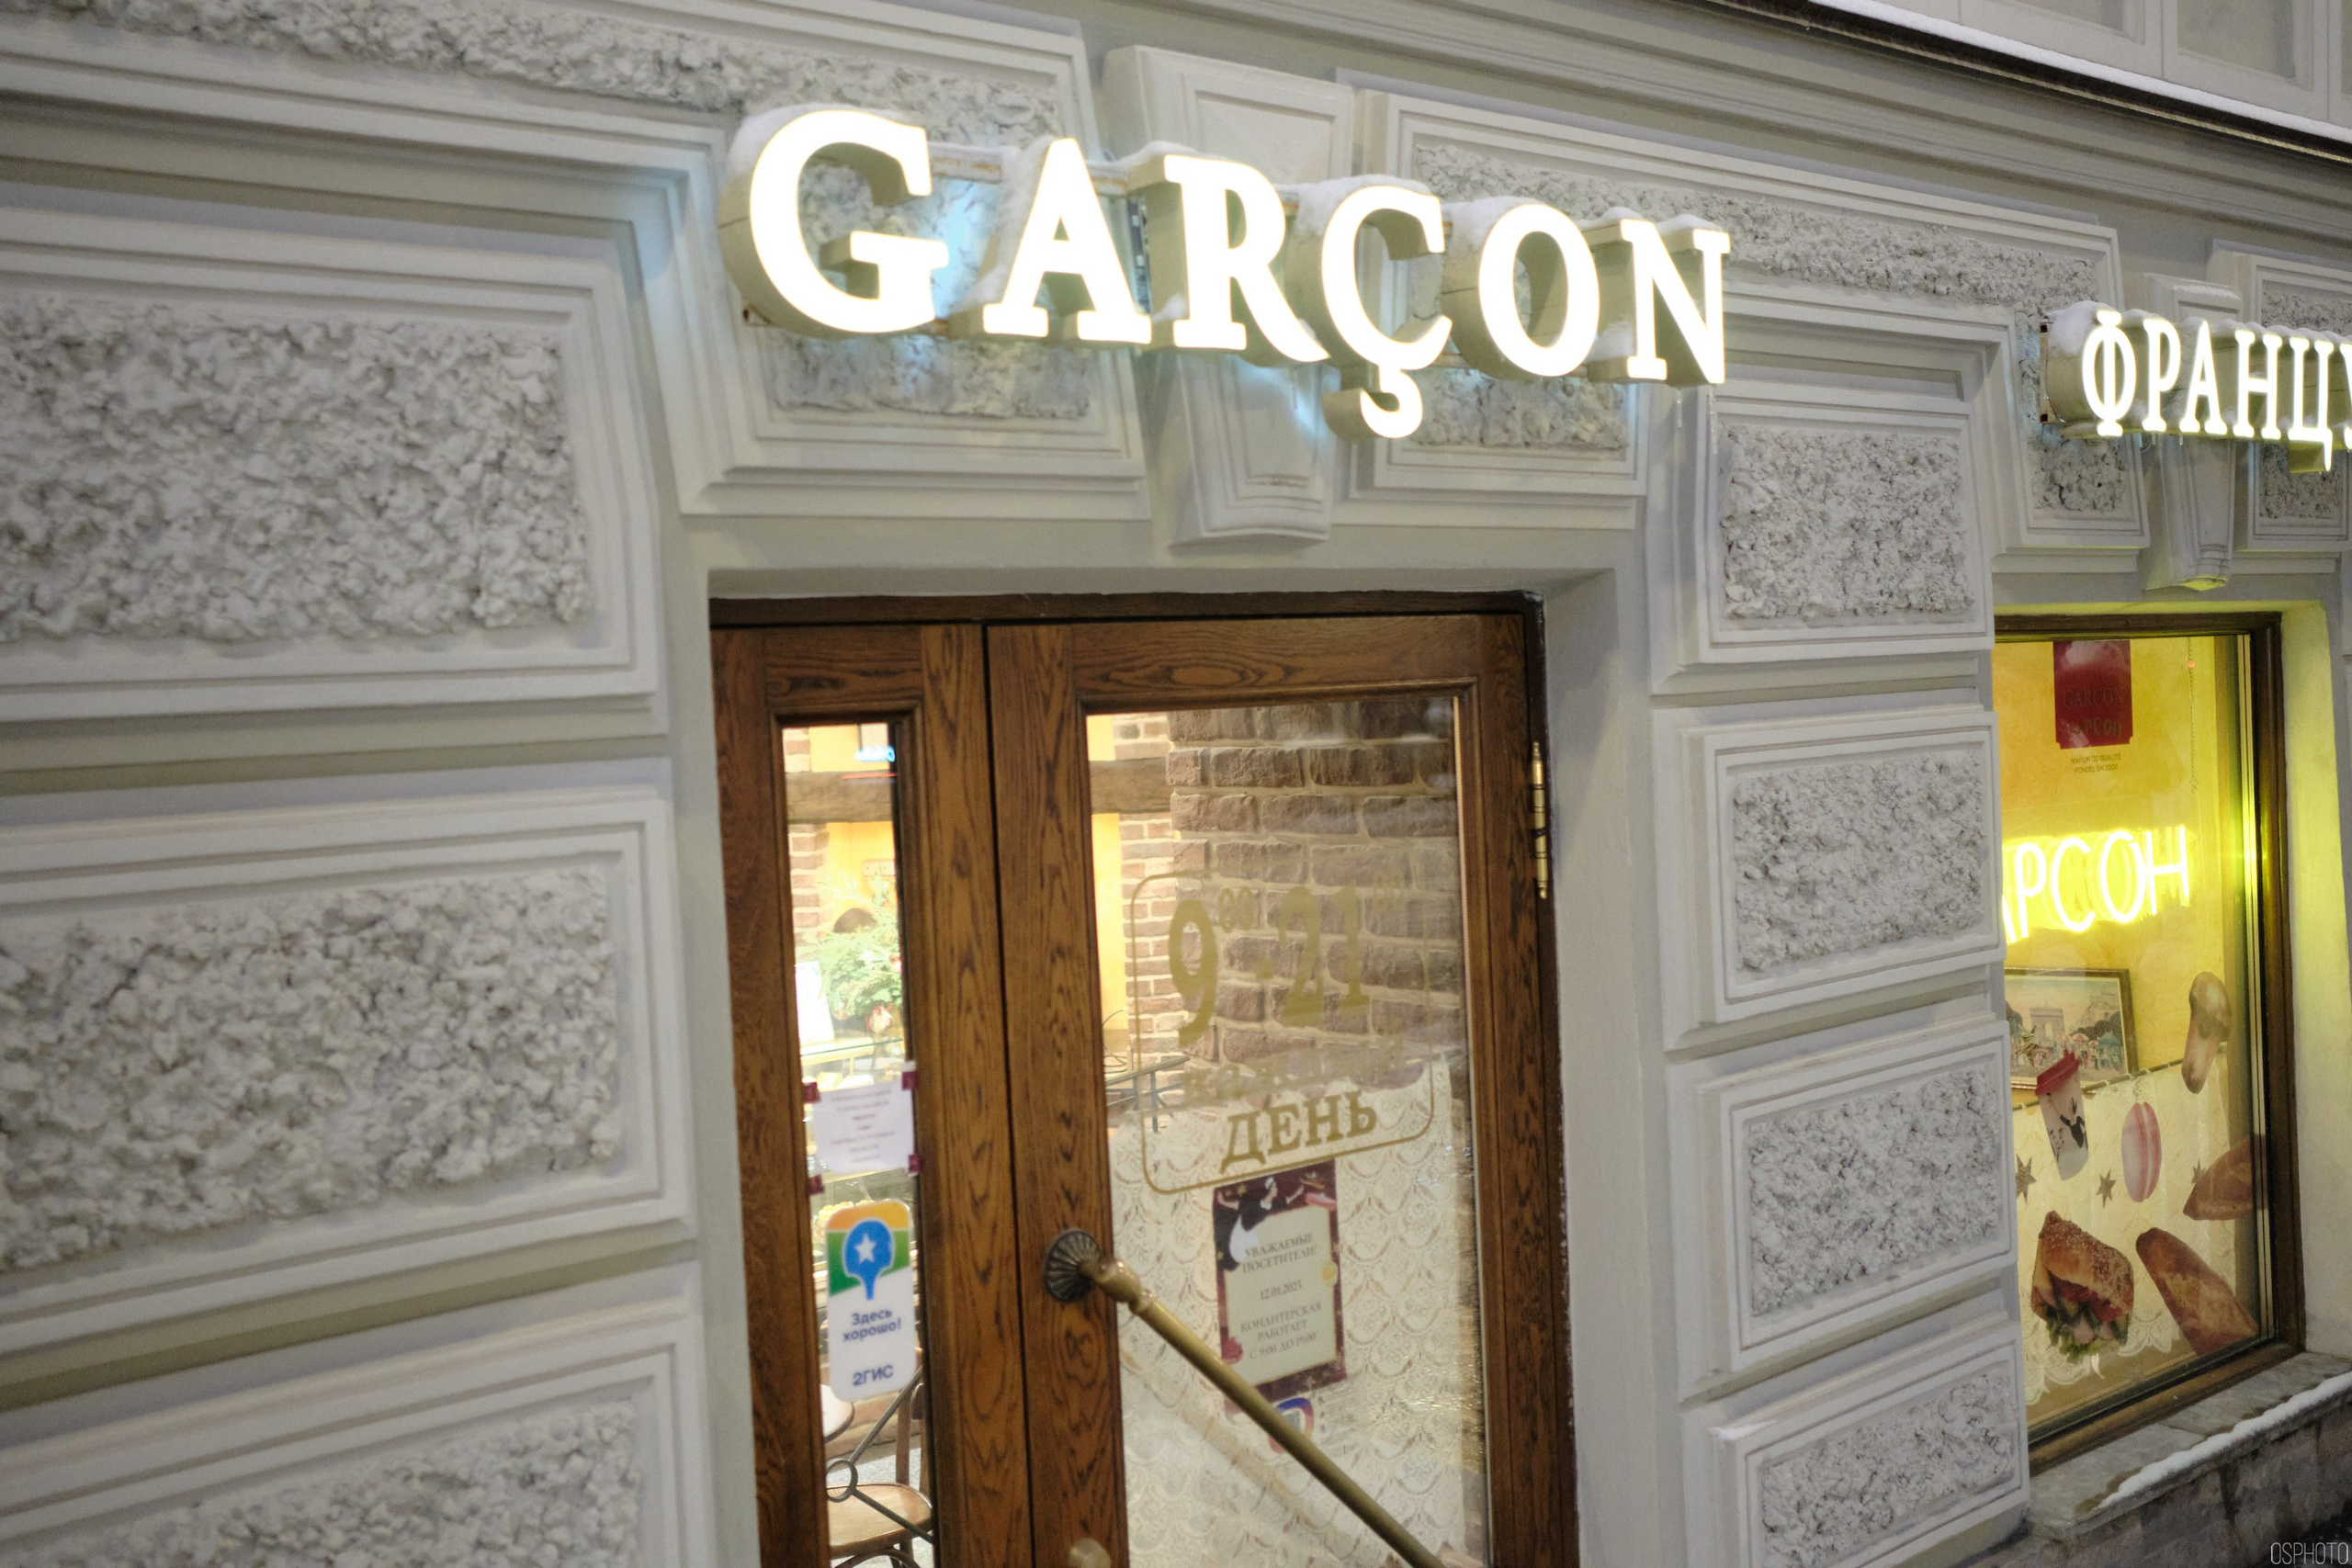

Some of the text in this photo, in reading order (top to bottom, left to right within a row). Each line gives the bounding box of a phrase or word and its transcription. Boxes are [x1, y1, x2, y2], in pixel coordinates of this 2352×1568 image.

[750, 109, 1731, 438] GARÇON
[1219, 1090, 1377, 1174] ДЕНЬ
[1245, 1233, 1313, 1258] УВАЖАЕМЫЕ
[1242, 1246, 1317, 1274] ПОСЕТИТЕЛИ!
[842, 1316, 901, 1341] хорошо!
[852, 1309, 892, 1326] Здесь
[1240, 1302, 1321, 1333] КОНДИТЕРСКАЯ
[1257, 1319, 1307, 1342] РАБОТАЕТ
[853, 1363, 894, 1387] 2ГИС
